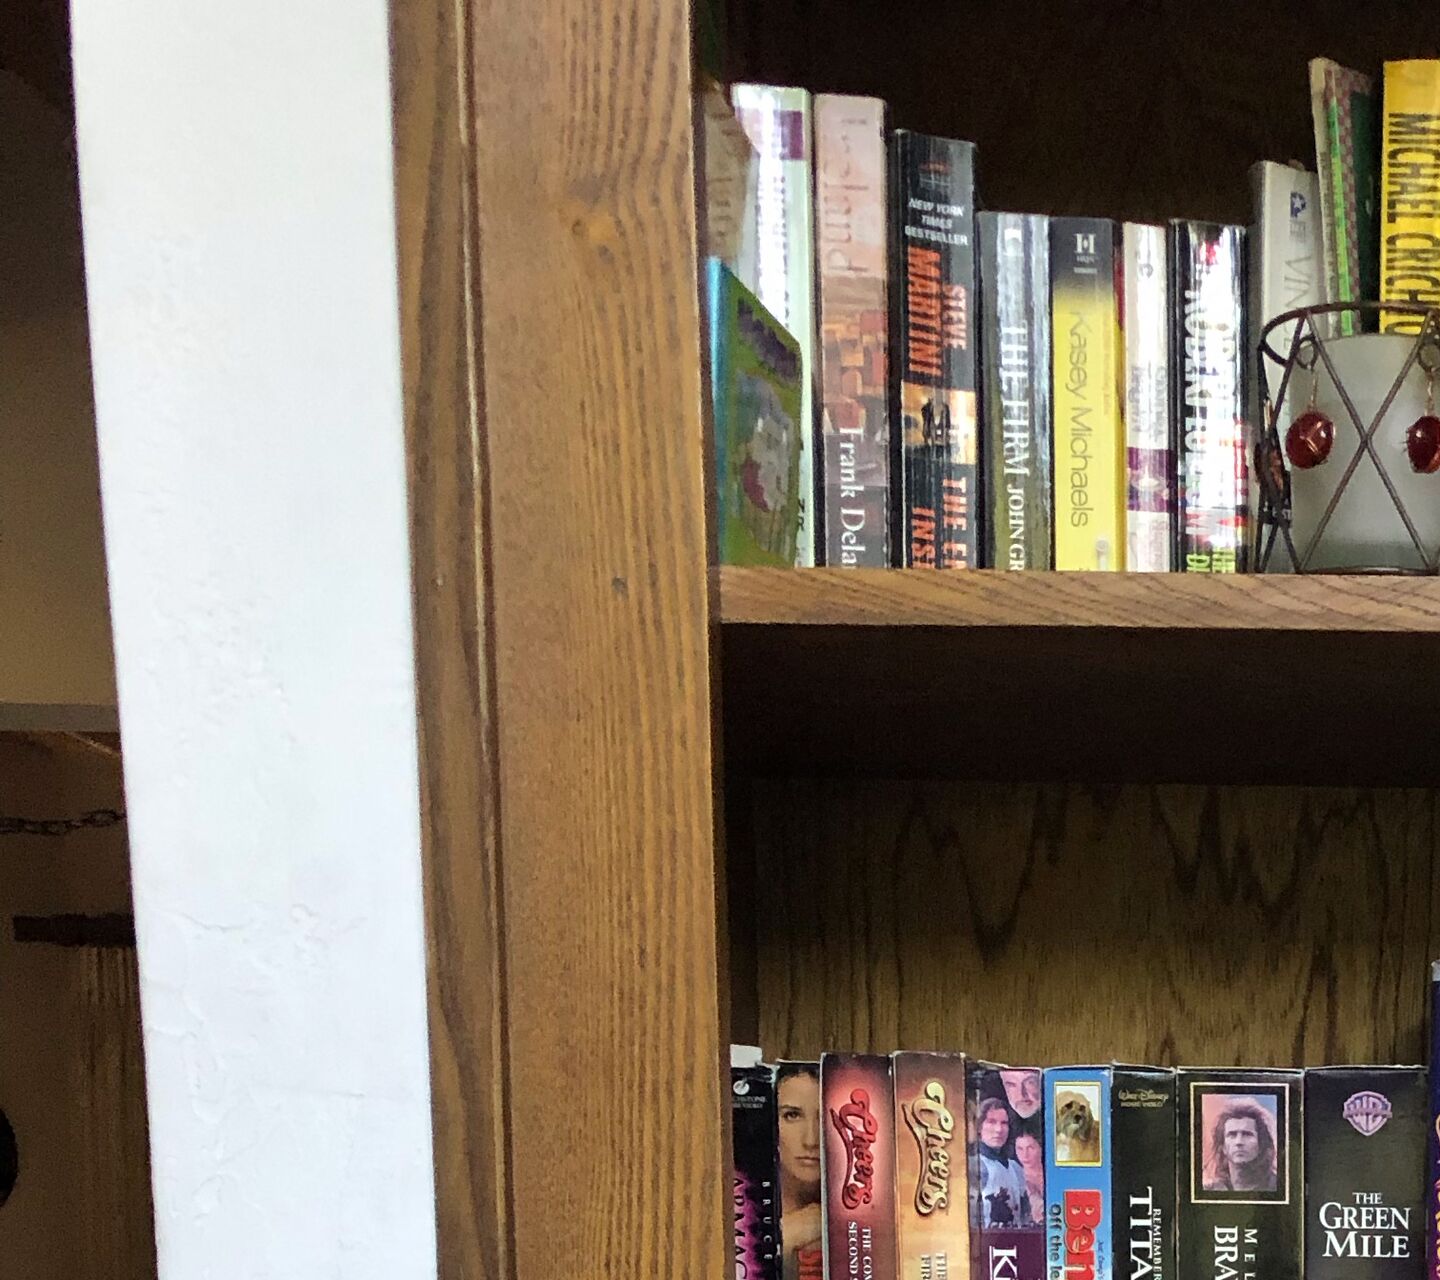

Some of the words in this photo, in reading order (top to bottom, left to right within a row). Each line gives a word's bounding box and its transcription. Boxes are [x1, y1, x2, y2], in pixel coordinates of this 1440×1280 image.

[904, 225, 968, 246] BESTSELLER
[908, 198, 934, 212] NEW
[937, 203, 964, 217] YORK
[907, 246, 942, 378] MARTINI
[942, 284, 968, 351] STEVE
[1000, 322, 1030, 392] THE
[1064, 312, 1094, 401] Kasey
[838, 426, 868, 499] Frank
[1001, 398, 1031, 477] FIRM
[1068, 407, 1094, 528] Michaels
[942, 477, 969, 532] THE
[1006, 483, 1026, 541] JOHN
[829, 1088, 879, 1212] Cheers
[902, 1080, 955, 1218] Cheers
[762, 1180, 776, 1261] BRUCE
[1049, 1203, 1062, 1231] Off
[1318, 1201, 1414, 1231] GREEN
[1351, 1191, 1383, 1205] THE
[847, 1221, 861, 1274] SECOND
[861, 1225, 874, 1250] THE
[935, 1251, 949, 1278] THE
[1050, 1234, 1063, 1262] the
[1152, 1208, 1162, 1280] REMEMBER
[1321, 1230, 1412, 1259] MILE
